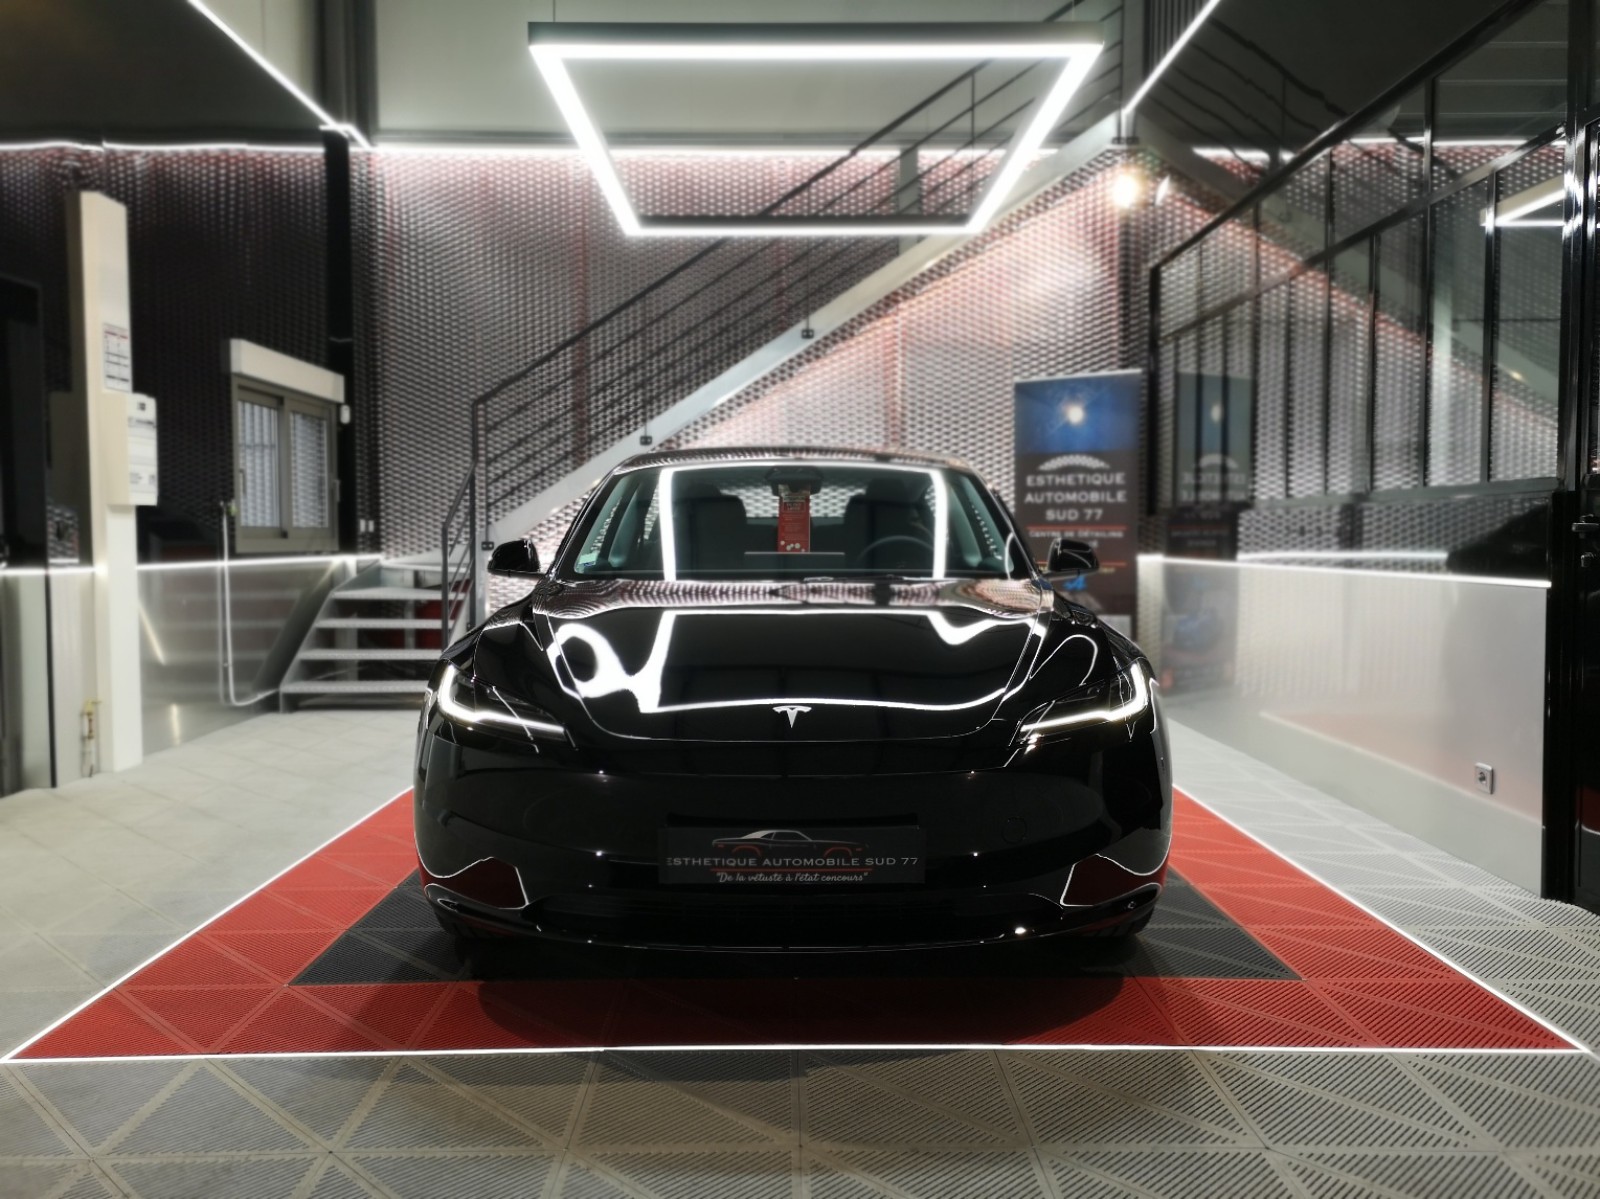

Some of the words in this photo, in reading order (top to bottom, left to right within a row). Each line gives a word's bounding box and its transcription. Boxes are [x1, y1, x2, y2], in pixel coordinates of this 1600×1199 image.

[1026, 472, 1126, 487] ESTHETIQUE
[1024, 490, 1127, 504] AUTOMOBILE
[1045, 508, 1079, 521] SUD
[1083, 508, 1103, 520] 77
[666, 857, 757, 867] ESTHETIQUE
[762, 857, 860, 867] AUTOMOBILE
[864, 857, 896, 866] SUD
[901, 857, 919, 866] 77
[735, 872, 746, 882] la
[785, 872, 793, 882] à
